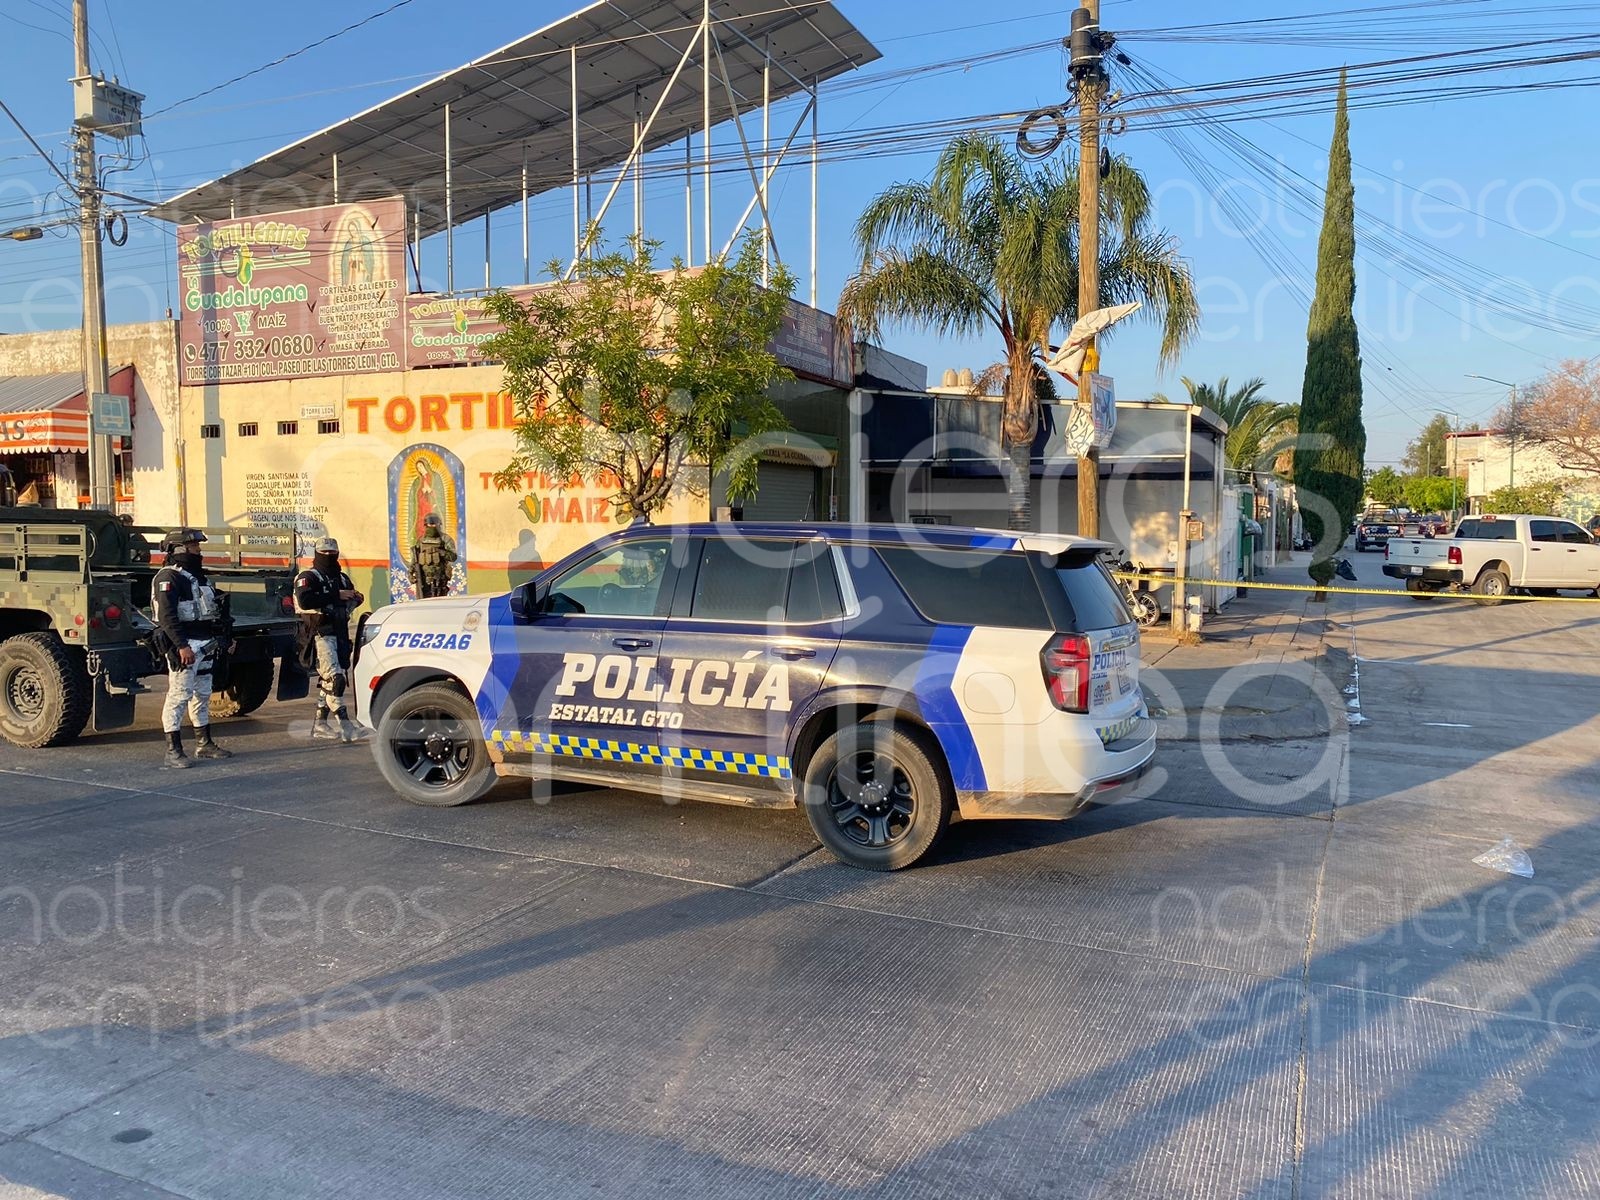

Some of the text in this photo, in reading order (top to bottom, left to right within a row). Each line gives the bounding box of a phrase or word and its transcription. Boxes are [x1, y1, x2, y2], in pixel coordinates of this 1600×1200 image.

[181, 221, 311, 262] TORTILLERIAS
[186, 276, 199, 290] LA
[319, 280, 398, 296] TORTILLAS CALIENTES
[185, 283, 309, 312] Guadalupana
[335, 291, 380, 304] ELABORADAS
[319, 308, 399, 325] BUEN TRATO Y PESO EXACTO
[409, 297, 488, 319] TORTILLE
[204, 320, 232, 334] 100%
[257, 312, 287, 329] MAÍZ
[328, 324, 348, 333] tortilla
[337, 331, 381, 341] MASA MOLIDA
[412, 332, 500, 347] Guadalupa
[199, 334, 314, 361] 477 332 0680
[335, 343, 353, 352] MASA
[187, 352, 400, 380] TORRE CORTAZAR #101 COL. PASEO DE LAS TORRES LEON, GTO.
[268, 472, 299, 480] SANTISIMA
[479, 470, 585, 491] TTILLA
[263, 488, 284, 498] SEÑORA
[294, 498, 309, 506] AQUI
[542, 497, 610, 524] MAIZ
[384, 632, 472, 650] GT623A6
[555, 650, 792, 712] POLICÍA
[548, 703, 684, 729] ESTATAL GTO
